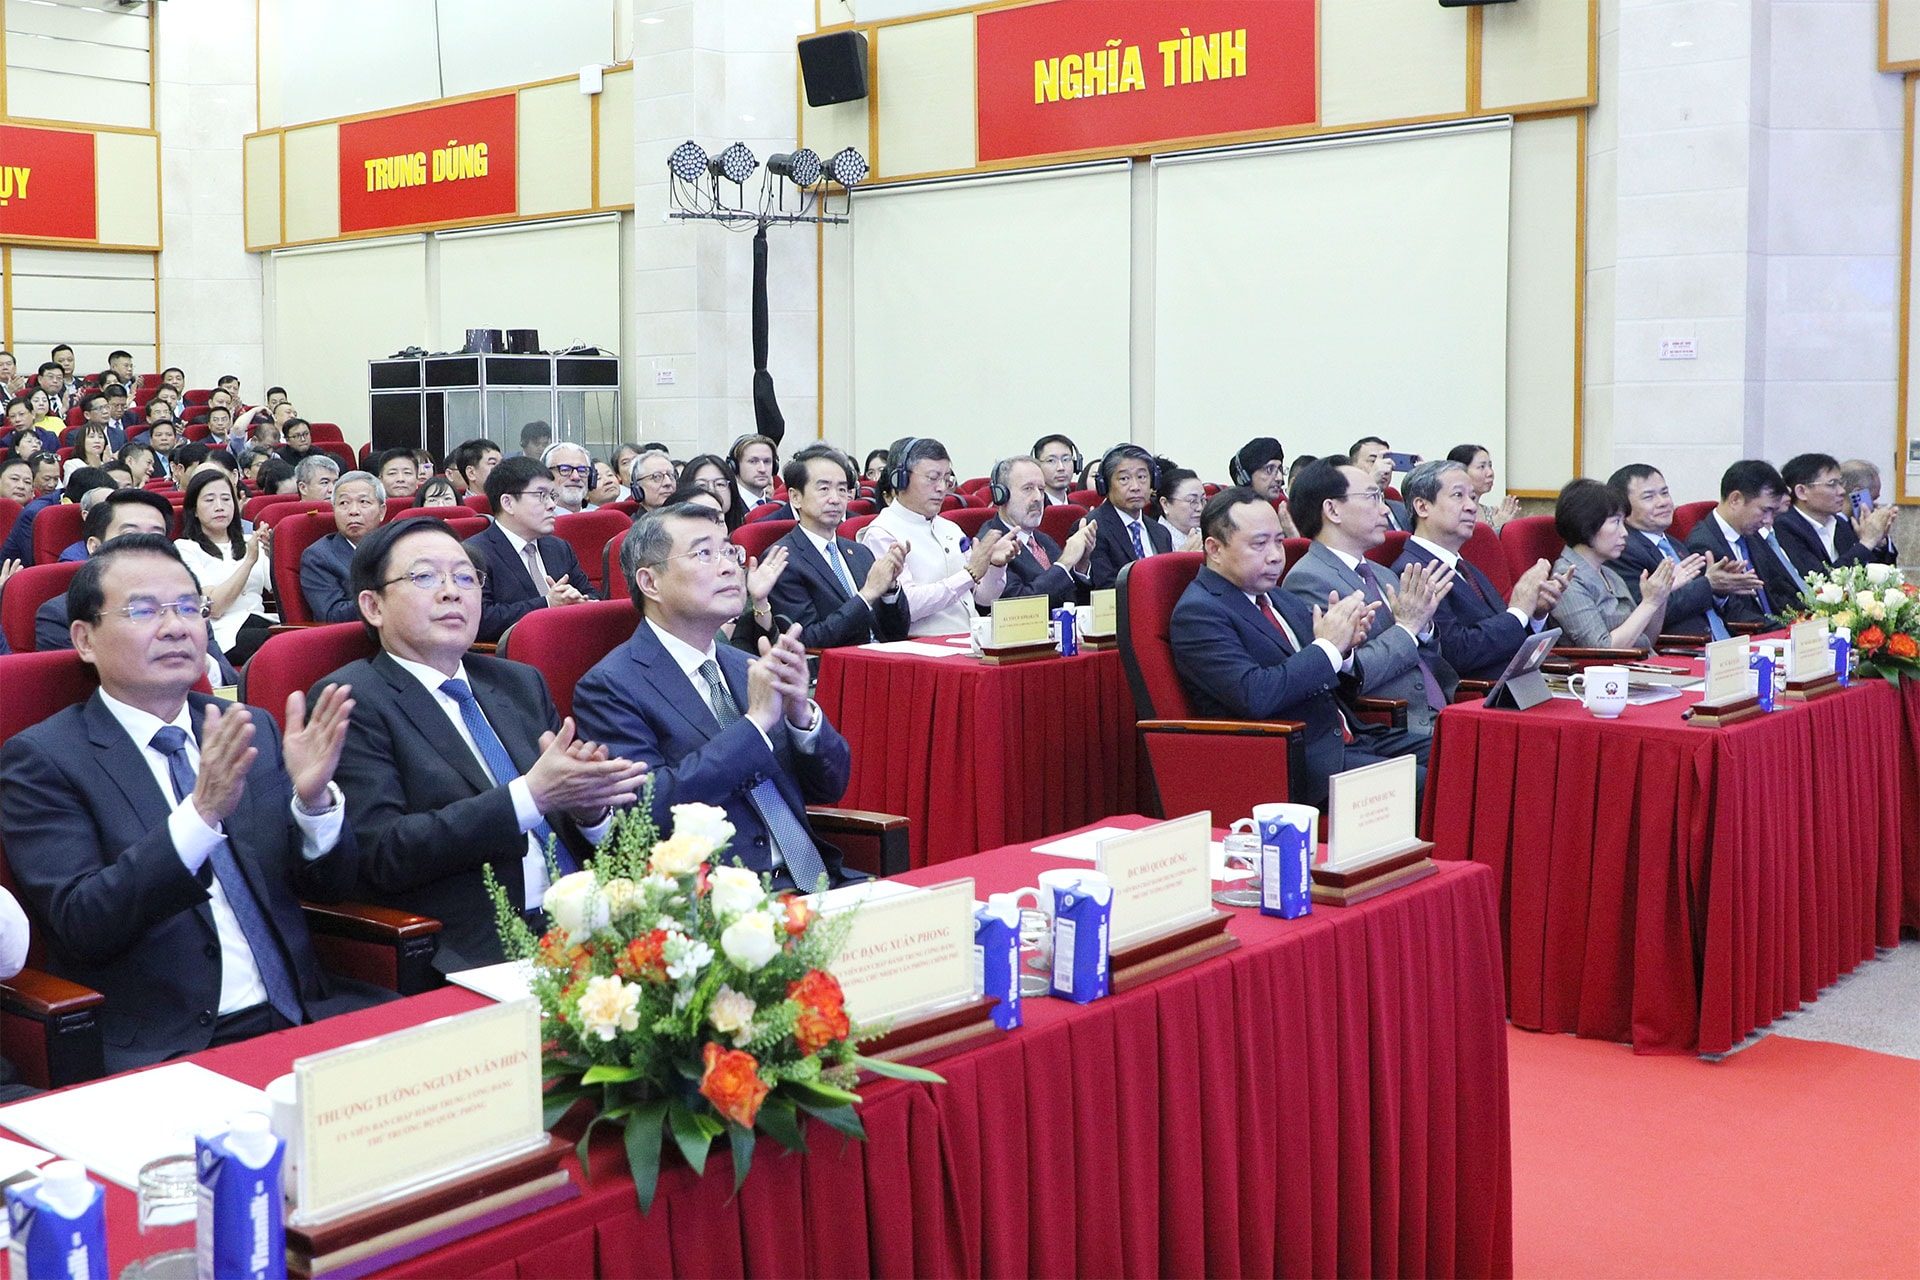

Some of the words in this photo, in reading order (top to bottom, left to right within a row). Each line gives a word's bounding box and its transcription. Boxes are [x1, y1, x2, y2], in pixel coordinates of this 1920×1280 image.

[1034, 38, 1146, 104] NGHĨA
[1158, 27, 1247, 87] TÌNH
[364, 151, 427, 192] TRUNG
[432, 139, 488, 183] DŨNG
[316, 1097, 374, 1127] THƯỢNG
[250, 1193, 269, 1273] Vinamilk
